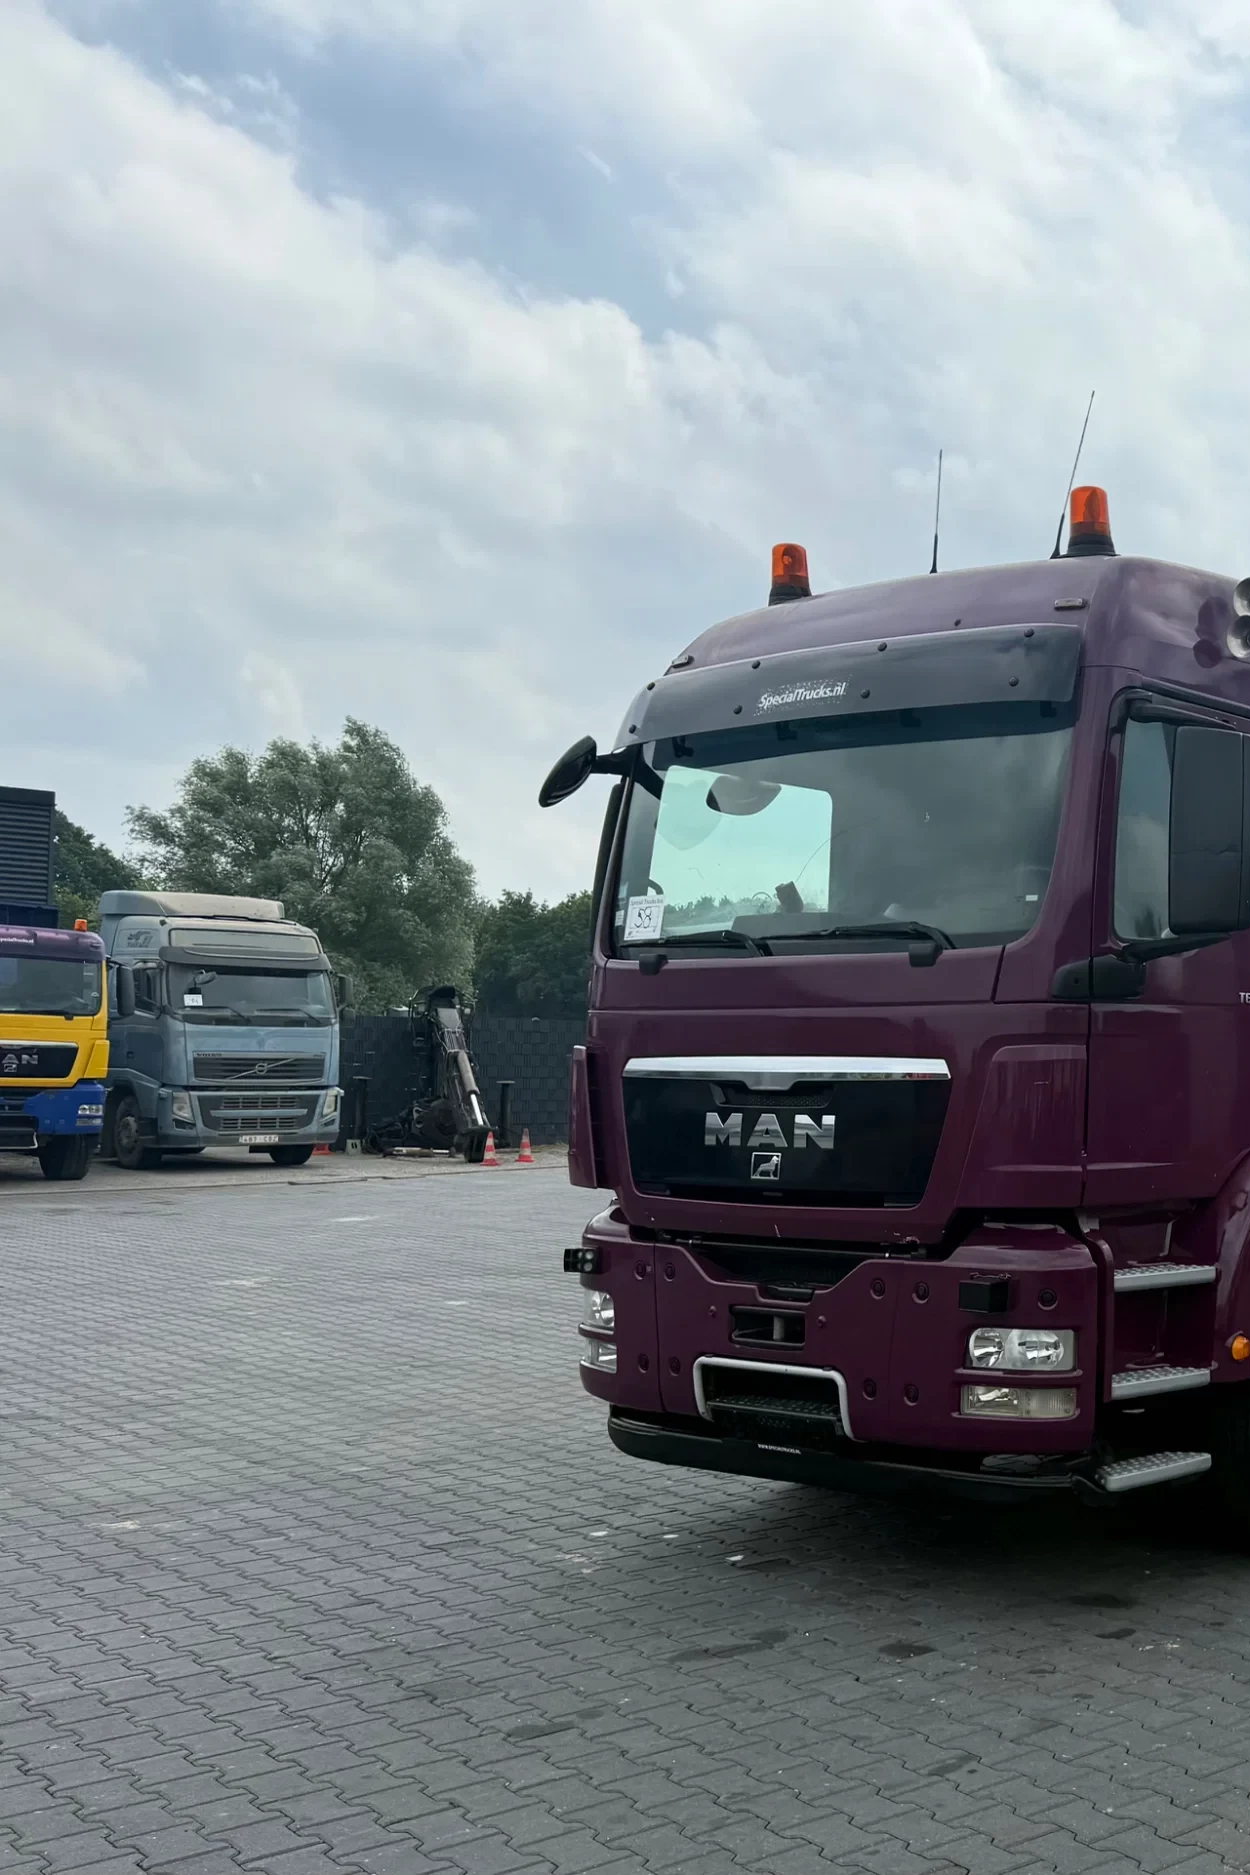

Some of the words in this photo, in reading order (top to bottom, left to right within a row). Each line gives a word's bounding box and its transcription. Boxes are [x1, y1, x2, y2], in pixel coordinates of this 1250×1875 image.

[758, 682, 846, 709] SpecialTrucks.nl
[634, 906, 652, 929] 58
[1, 1053, 39, 1065] AN
[704, 1112, 836, 1149] MAN
